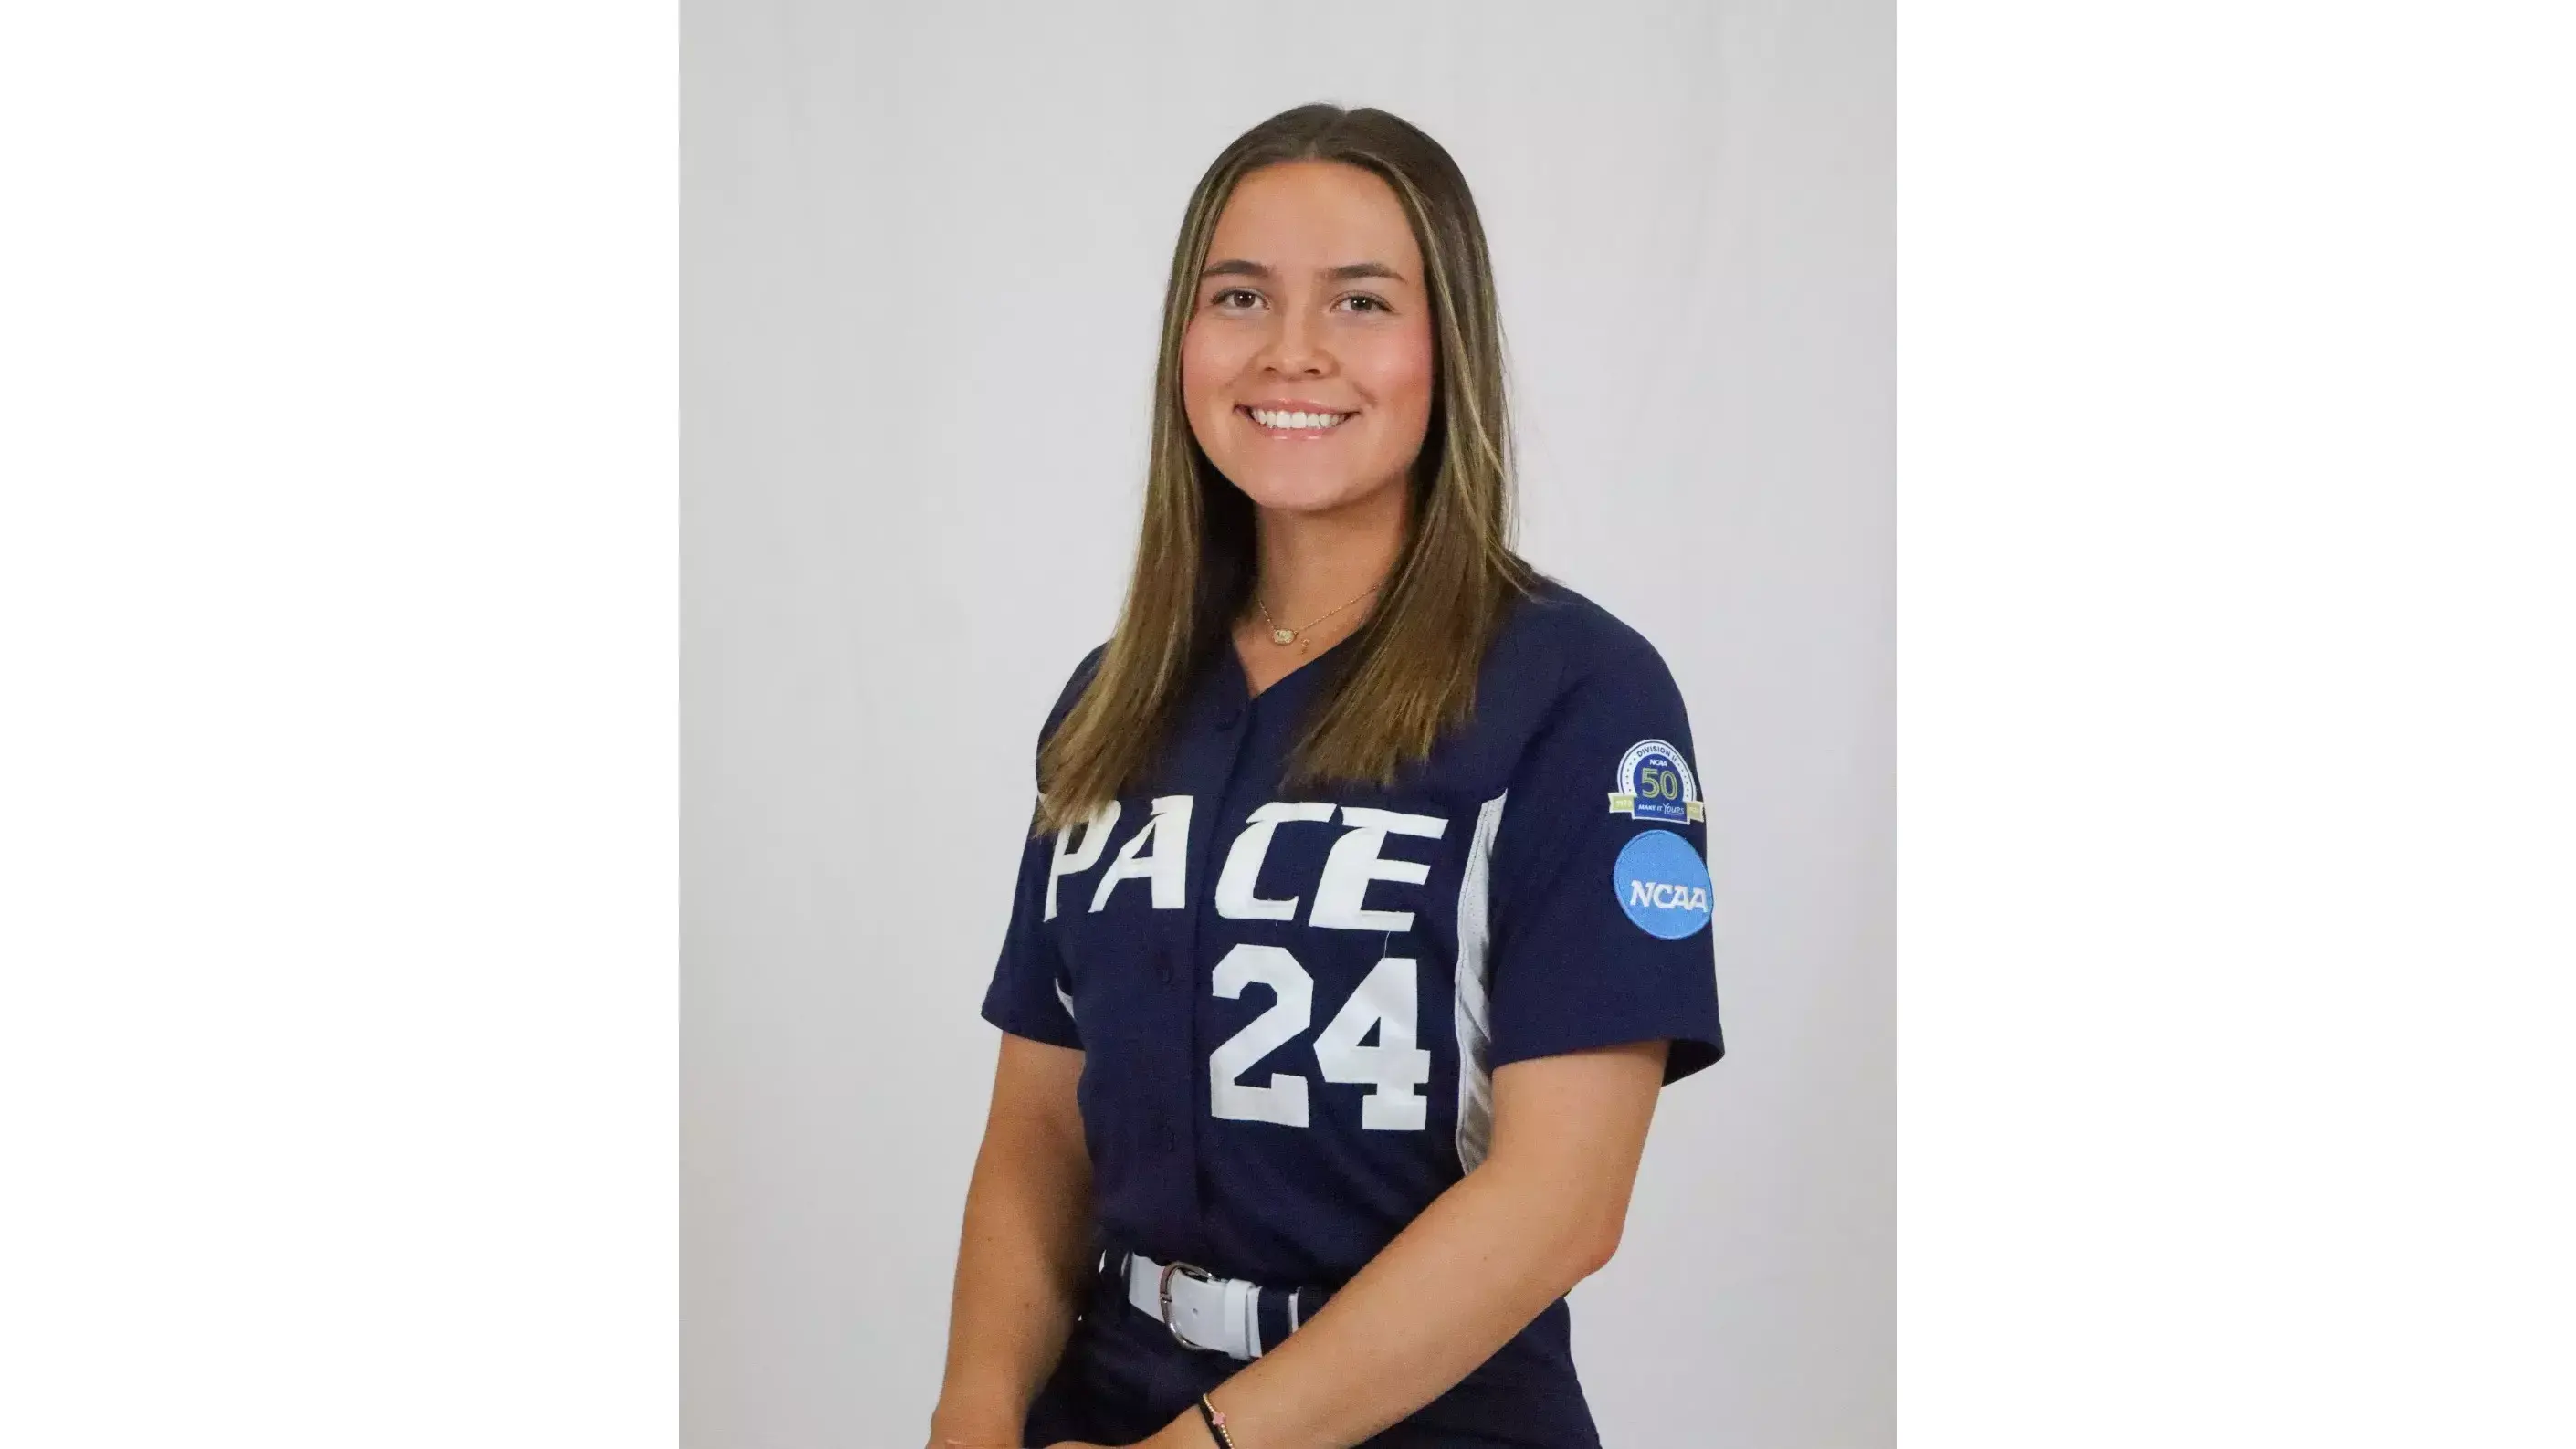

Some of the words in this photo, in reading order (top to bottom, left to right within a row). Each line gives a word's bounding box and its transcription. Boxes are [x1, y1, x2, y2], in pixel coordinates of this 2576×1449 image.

[1636, 745, 1670, 758] DIVISION
[1649, 759, 1667, 767] NCAA
[1641, 767, 1678, 800] 50
[1043, 795, 1449, 932] PACE
[1630, 879, 1709, 913] NCAA
[1209, 943, 1431, 1131] 24
